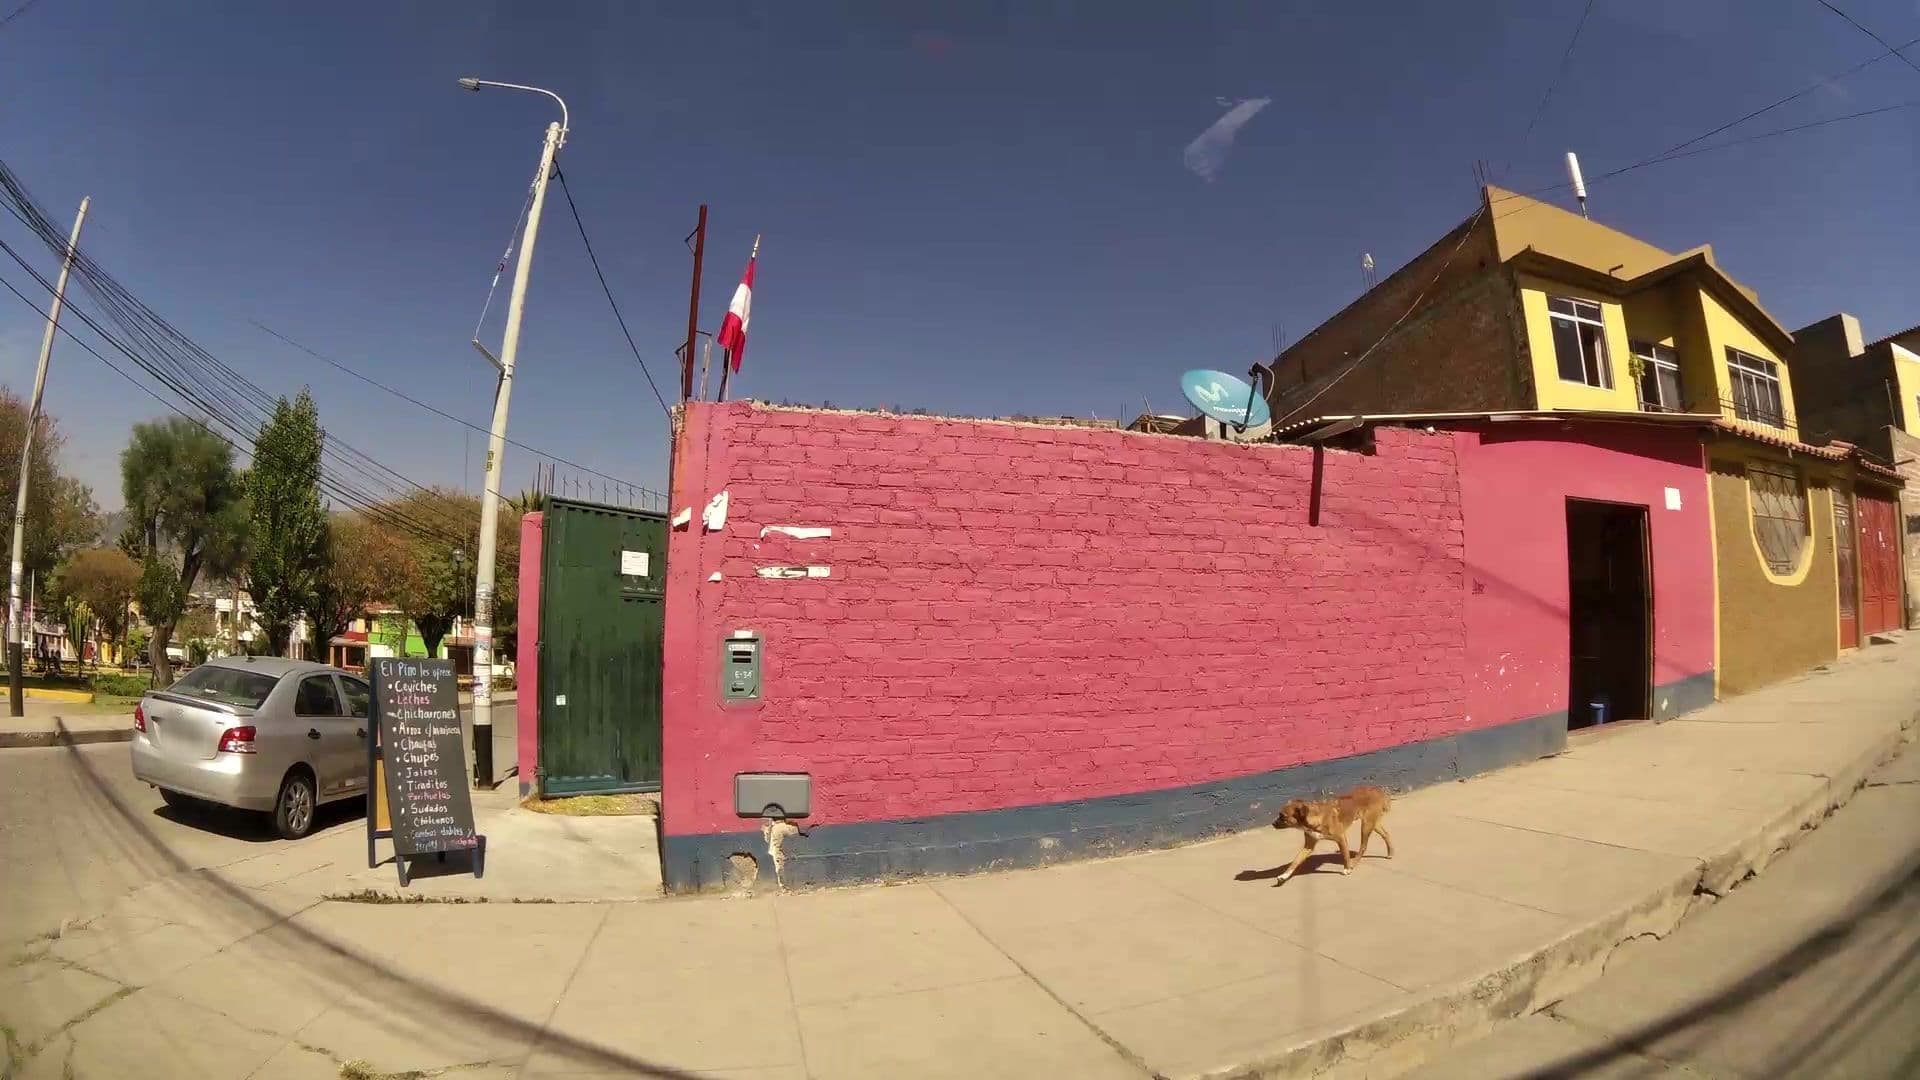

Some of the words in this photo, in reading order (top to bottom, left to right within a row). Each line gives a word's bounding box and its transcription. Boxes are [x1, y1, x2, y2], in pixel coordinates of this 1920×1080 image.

[380, 660, 393, 677] El
[398, 661, 417, 677] Pino
[420, 663, 430, 680] les
[394, 680, 437, 693] Ceviches
[397, 692, 430, 705] Leches
[403, 752, 440, 767] Chupes
[405, 767, 438, 779] Jaleas
[406, 778, 448, 792] Tiraditos
[410, 803, 448, 814] Sudados
[413, 815, 455, 827] Chilcanos
